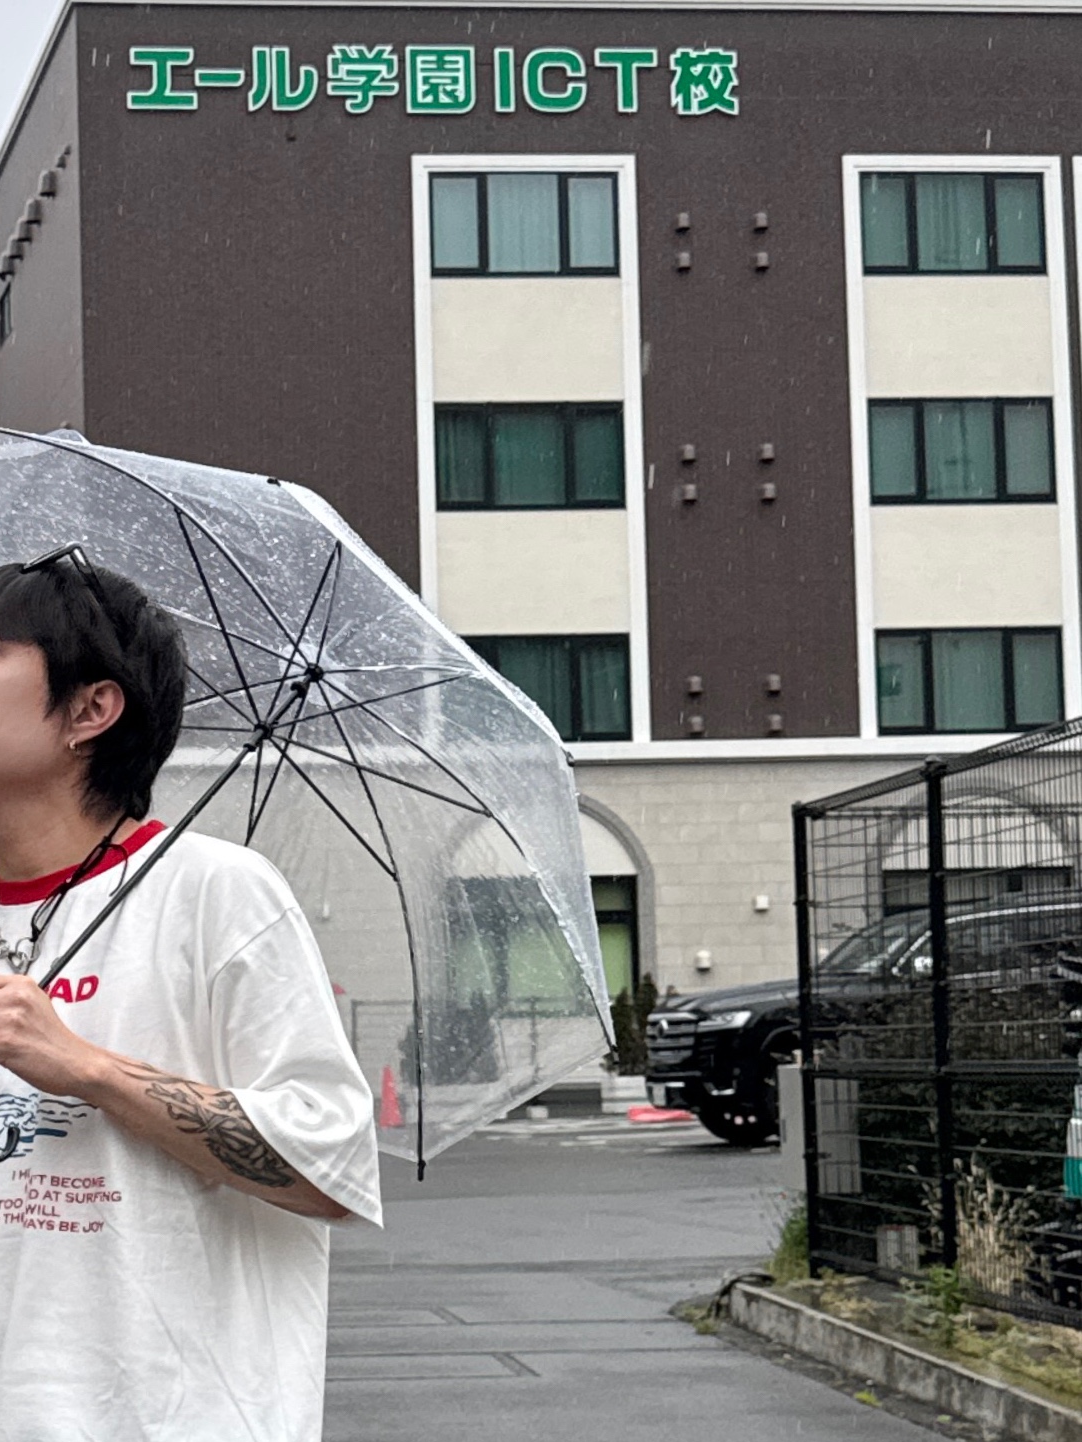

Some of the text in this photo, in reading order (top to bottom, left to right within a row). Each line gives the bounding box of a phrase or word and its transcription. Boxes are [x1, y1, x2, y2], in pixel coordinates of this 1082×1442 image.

[45, 975, 99, 1003] AD
[51, 1176, 105, 1188] BECOME
[42, 1190, 61, 1202] AT
[26, 1204, 60, 1217] WILL
[59, 1221, 79, 1232] BE
[83, 1221, 104, 1233] JOY
